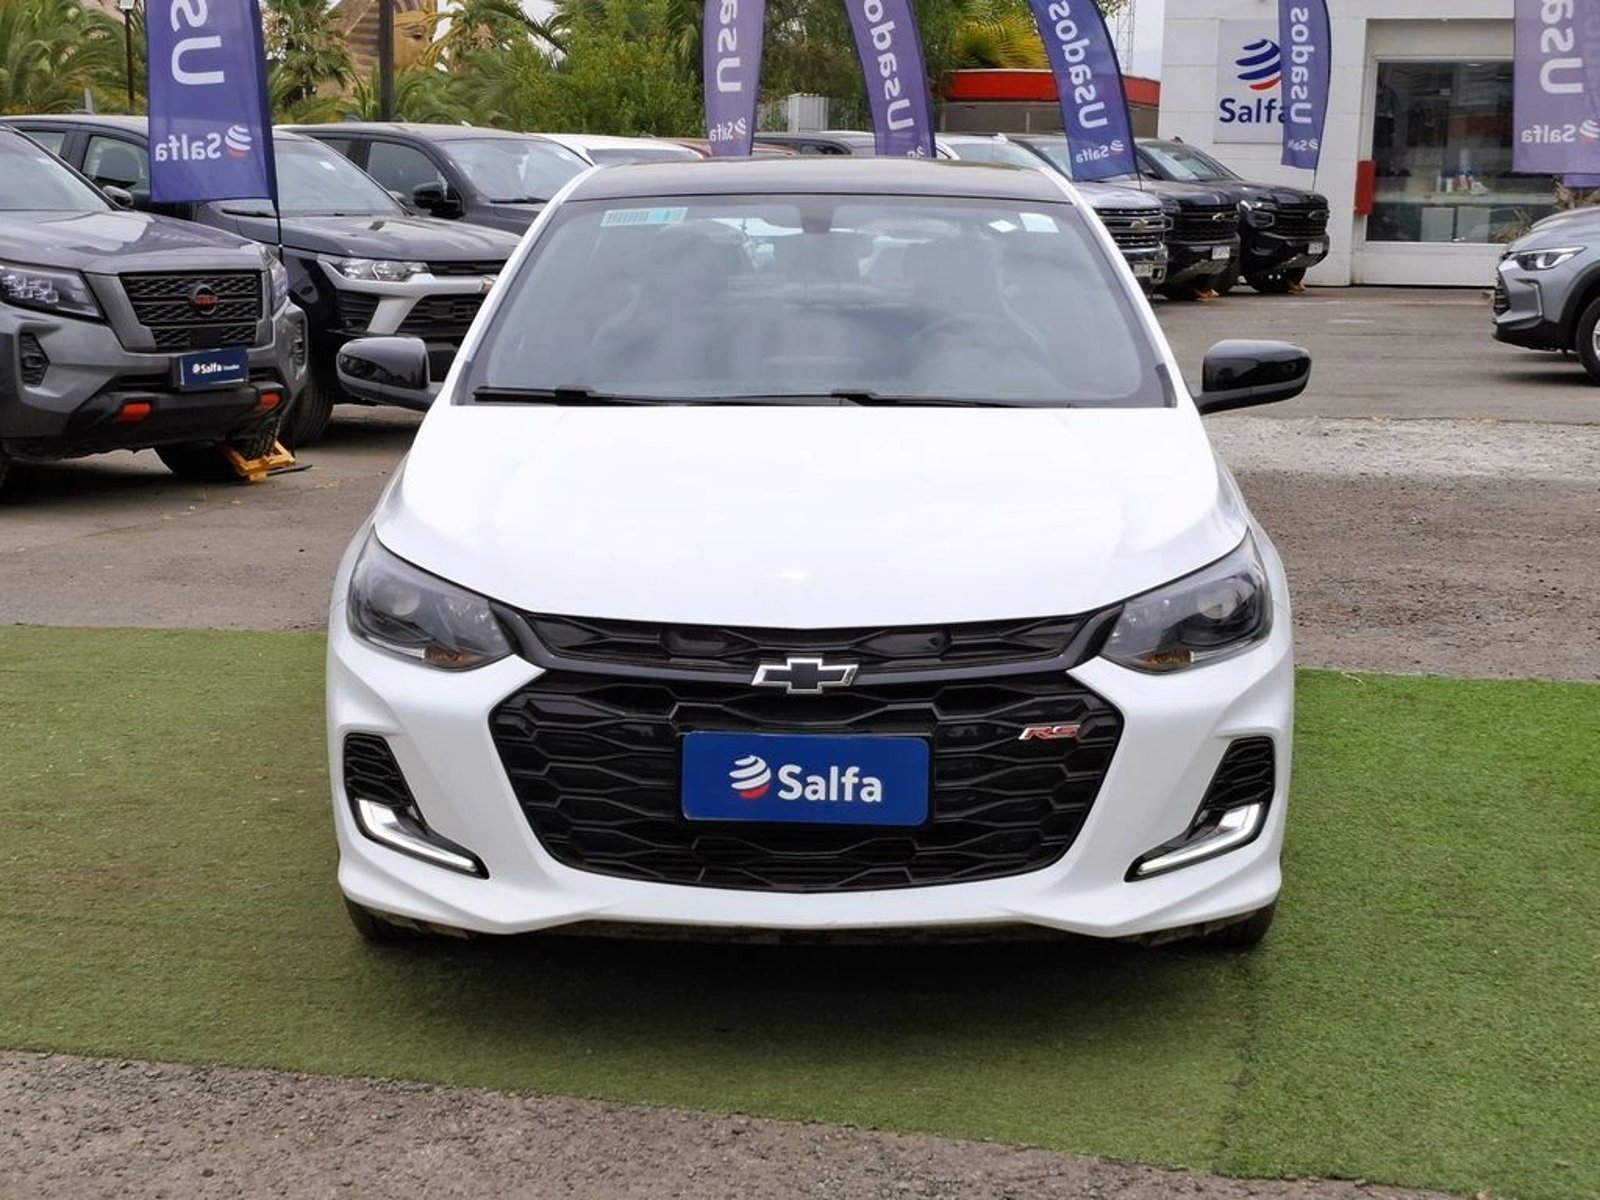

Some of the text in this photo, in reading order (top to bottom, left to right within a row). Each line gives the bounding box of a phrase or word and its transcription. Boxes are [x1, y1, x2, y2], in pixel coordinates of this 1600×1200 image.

[201, 362, 222, 374] Salfa
[1018, 724, 1081, 741] RS
[777, 763, 883, 803] Salfa
